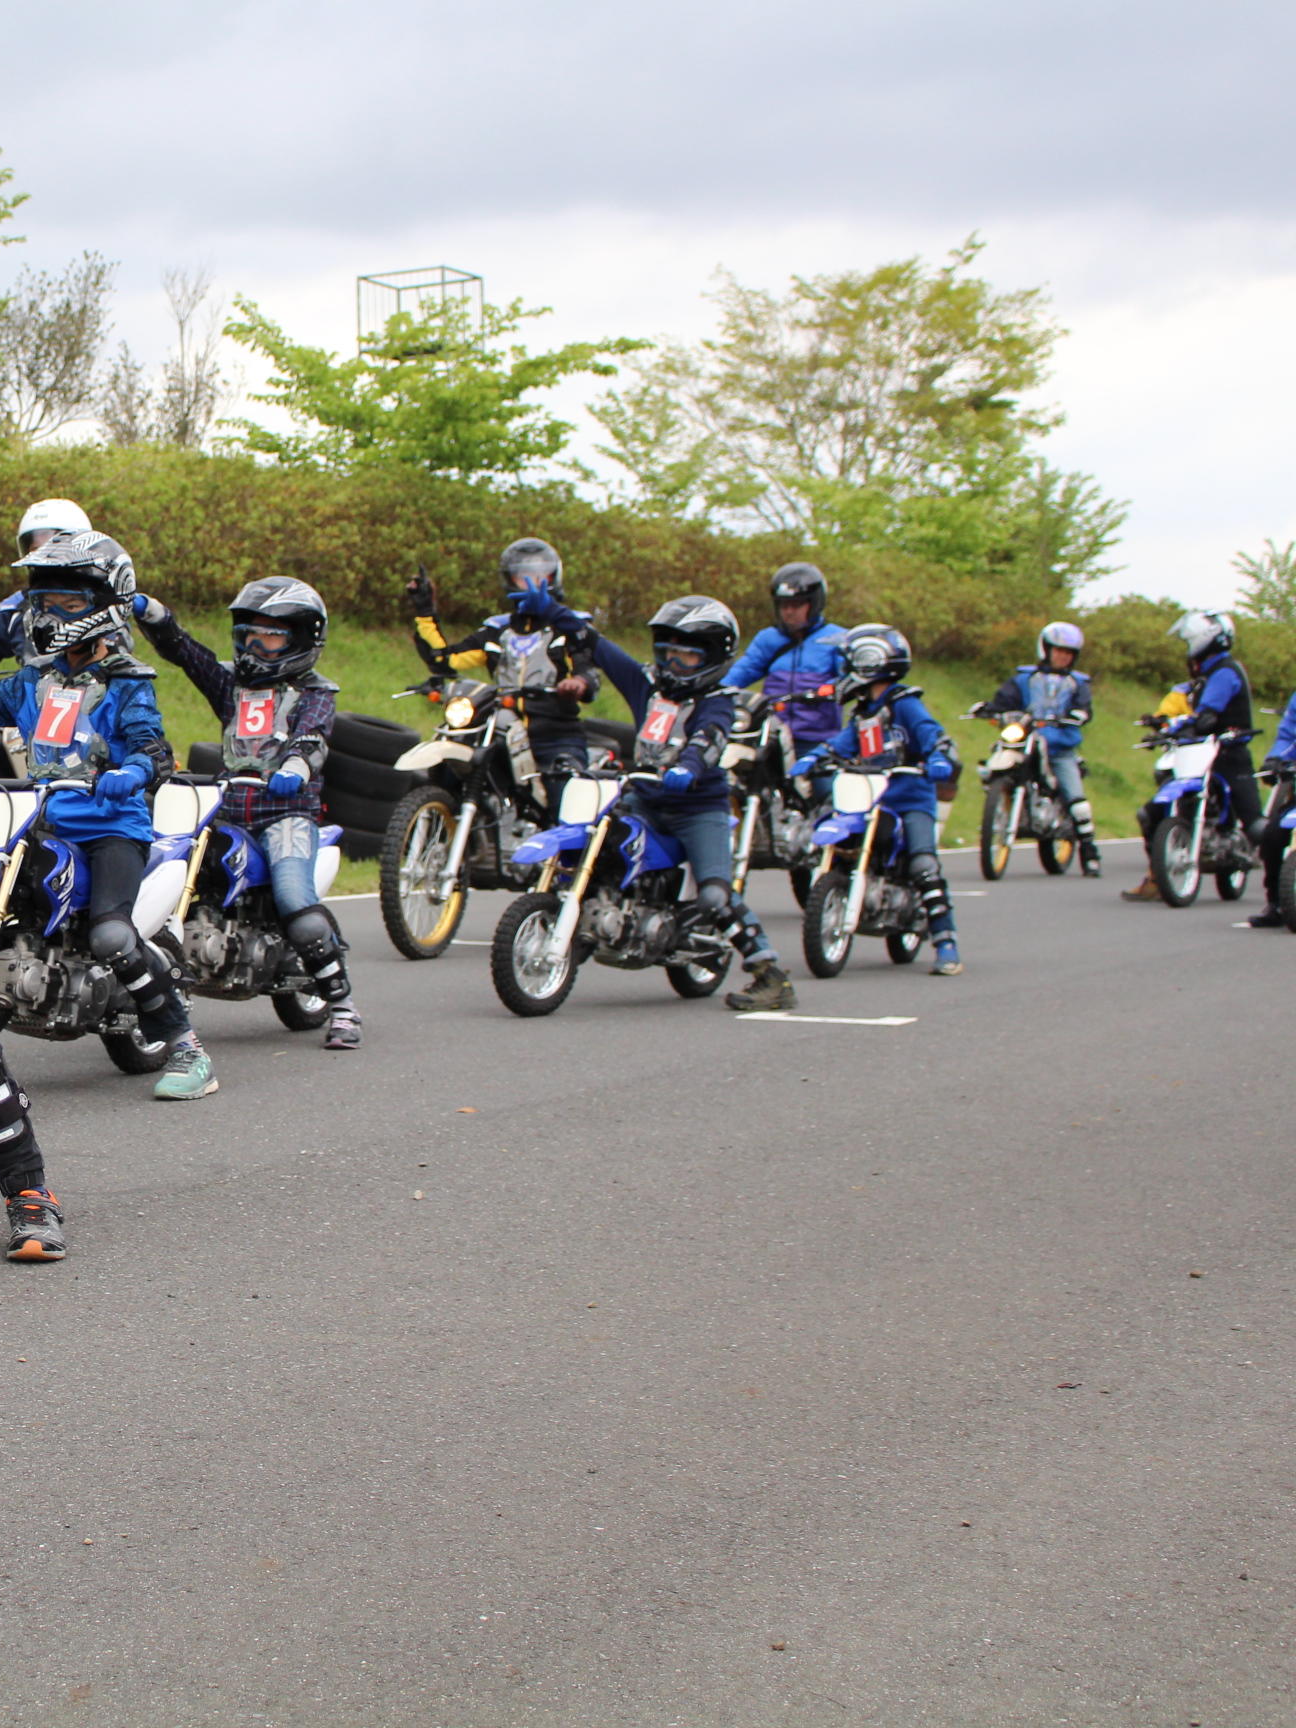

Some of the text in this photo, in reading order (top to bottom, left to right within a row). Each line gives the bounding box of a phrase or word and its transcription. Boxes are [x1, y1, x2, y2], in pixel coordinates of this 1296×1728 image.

[51, 700, 72, 737] 7
[245, 701, 265, 732] 5
[647, 713, 669, 740] 4
[864, 728, 875, 753] 1
